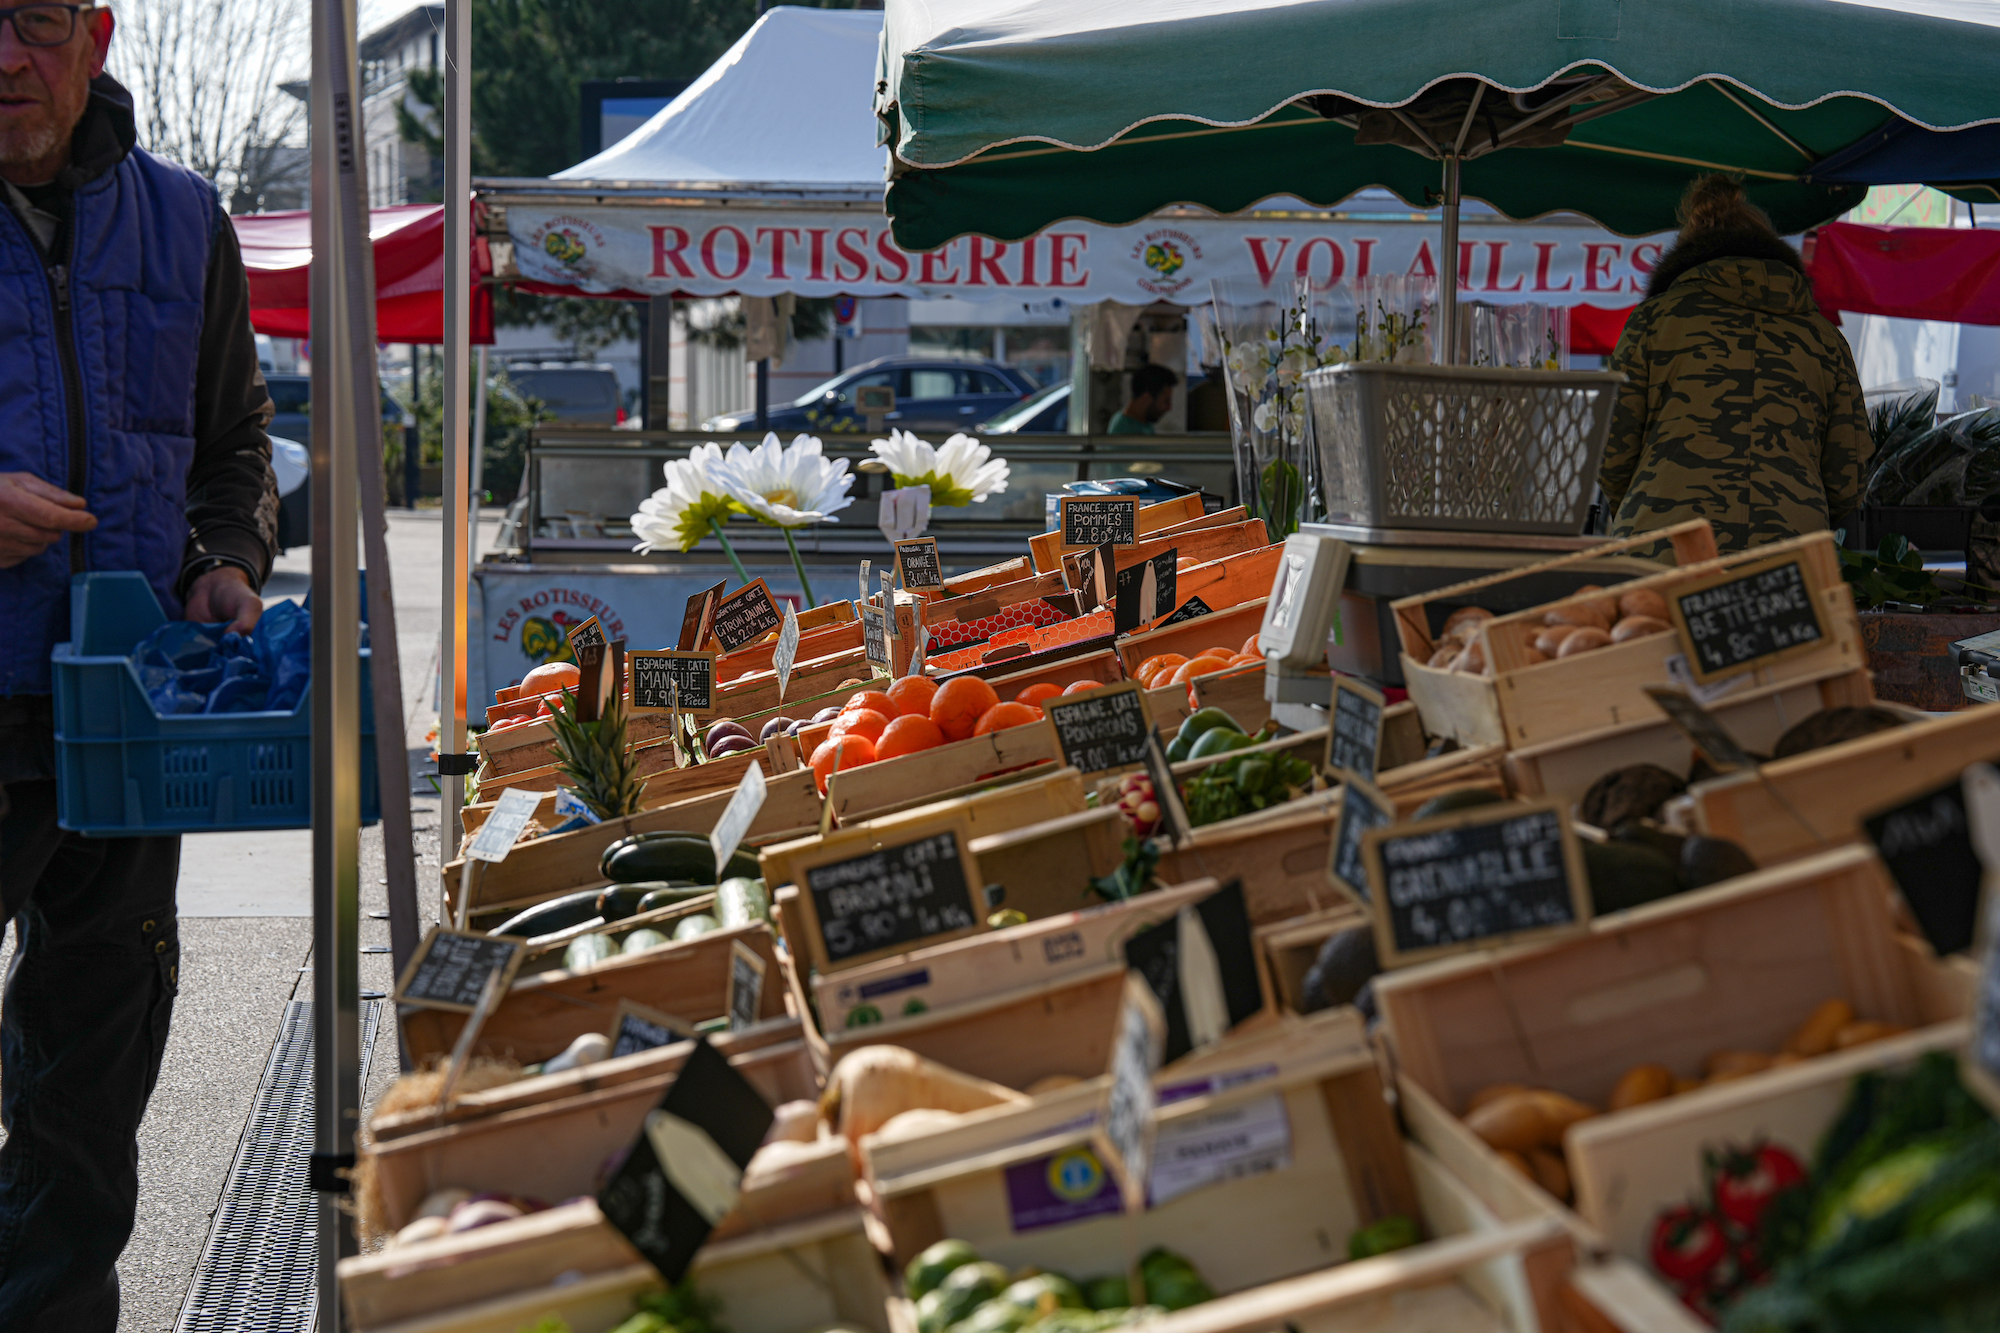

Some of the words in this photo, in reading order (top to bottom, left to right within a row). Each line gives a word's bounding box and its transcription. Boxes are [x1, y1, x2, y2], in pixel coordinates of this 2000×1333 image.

[646, 224, 1090, 287] ROTISSERIE
[1244, 236, 1664, 295] VOLAILLES
[1073, 512, 1122, 527] POMMES
[492, 608, 522, 643] LES
[741, 599, 772, 622] JAUNE
[1689, 583, 1807, 640] BETTERAVE
[1062, 711, 1138, 746] POIVRONS
